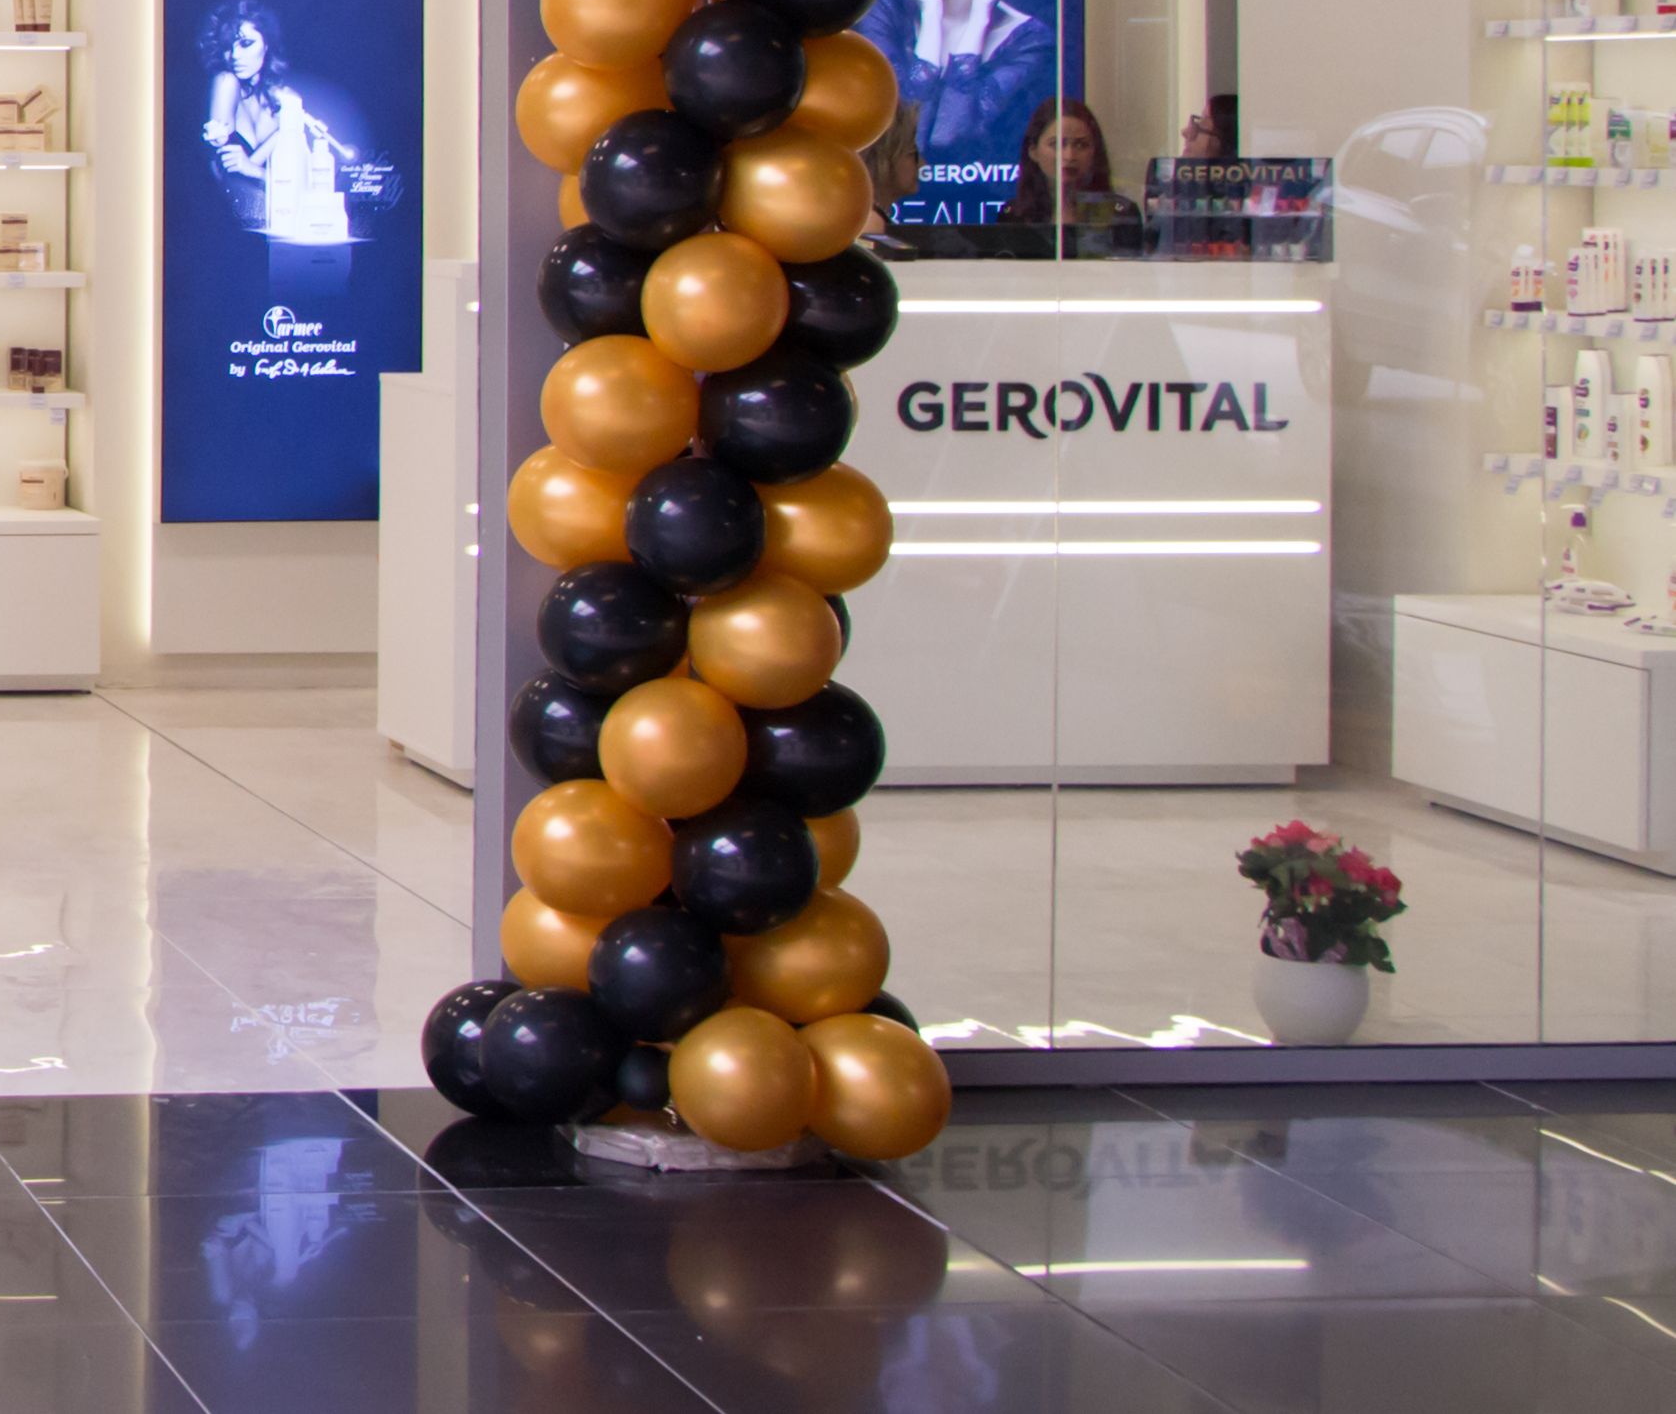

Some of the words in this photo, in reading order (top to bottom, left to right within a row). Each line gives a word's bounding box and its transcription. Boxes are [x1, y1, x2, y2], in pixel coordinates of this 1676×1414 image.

[918, 162, 1021, 184] GEROVITA
[230, 341, 289, 355] Original
[292, 340, 356, 353] Gerovital
[229, 363, 246, 377] by
[896, 372, 1290, 440] GEROVITAL
